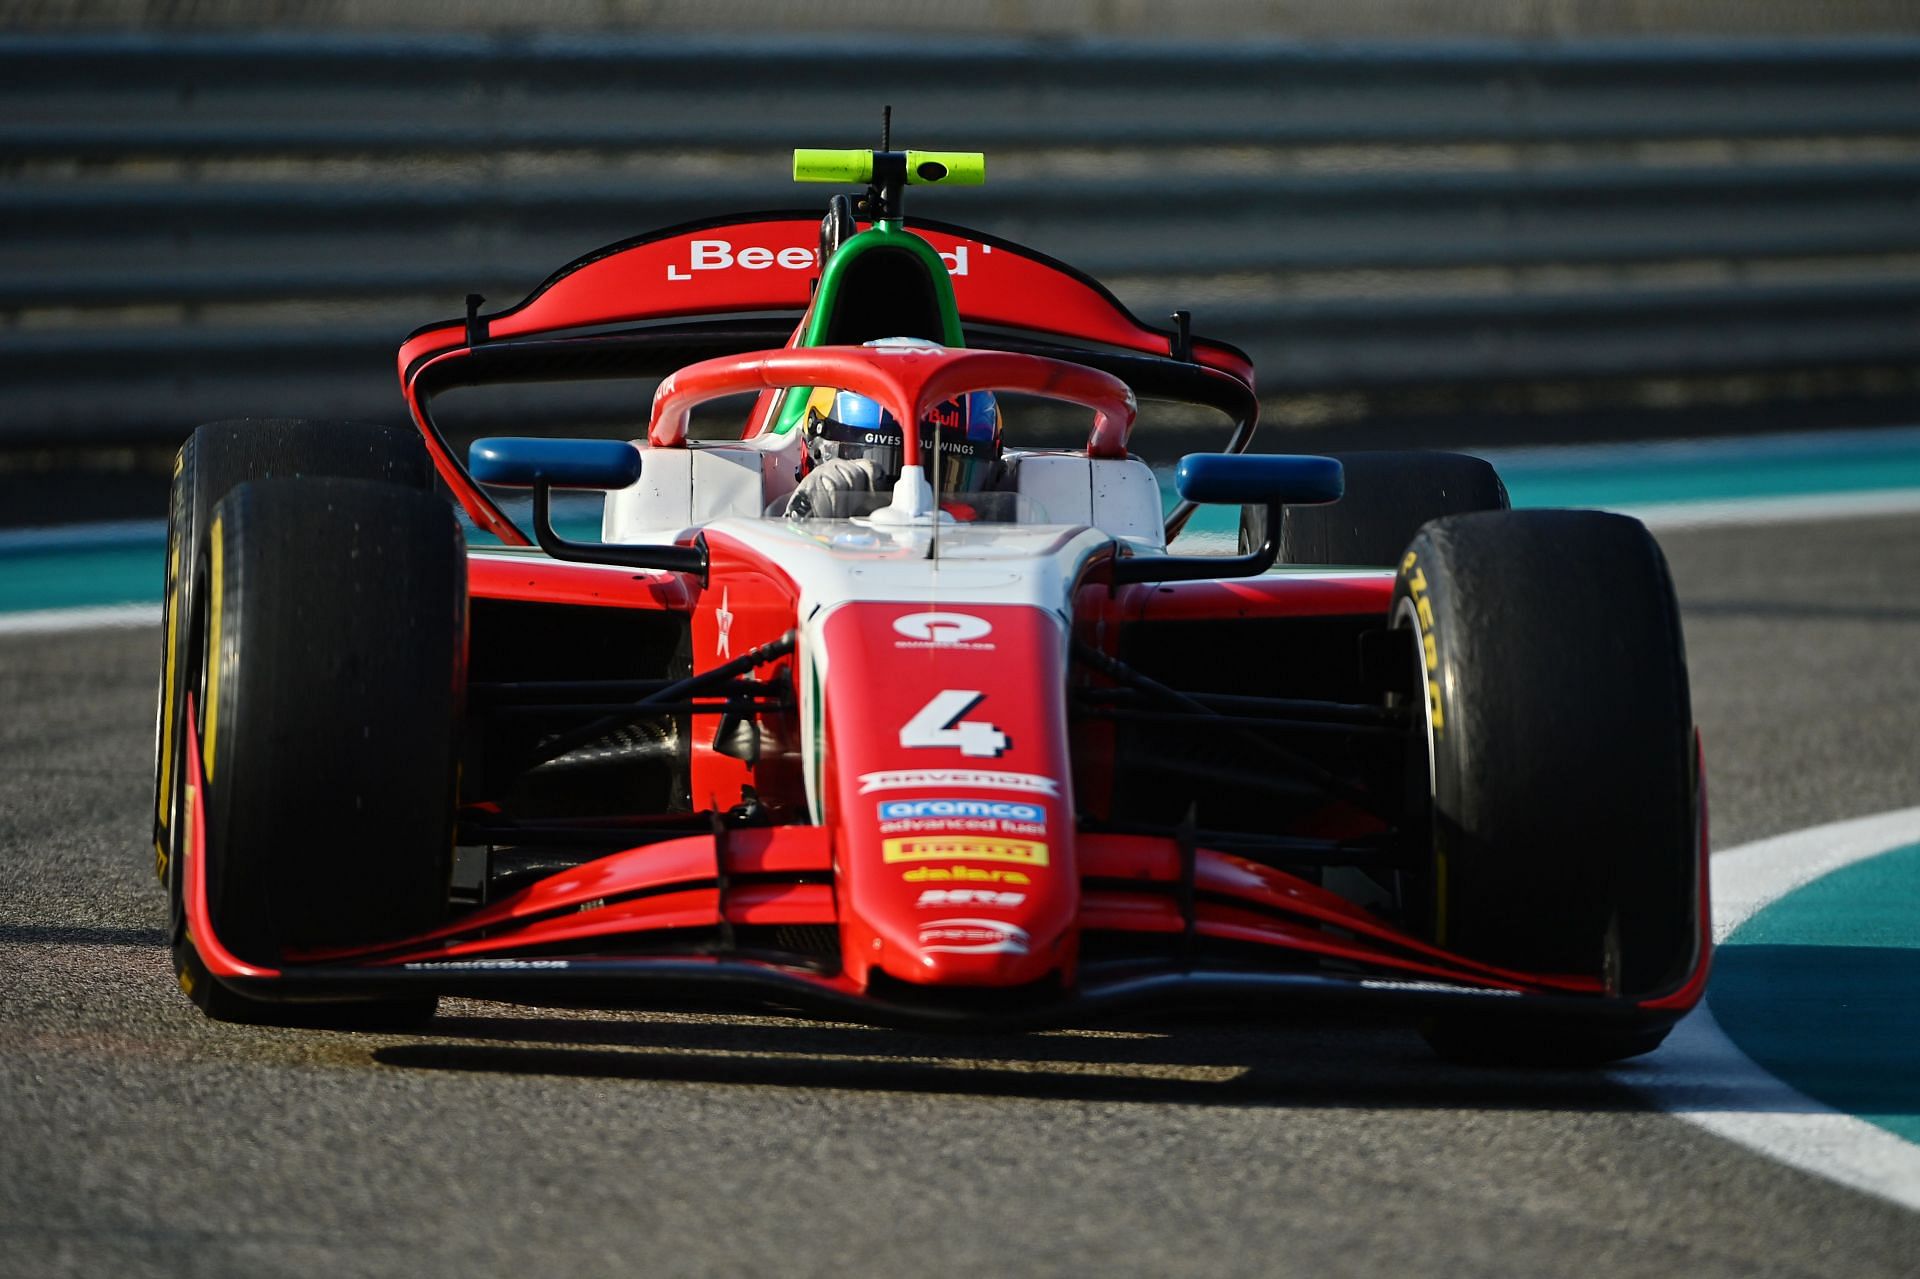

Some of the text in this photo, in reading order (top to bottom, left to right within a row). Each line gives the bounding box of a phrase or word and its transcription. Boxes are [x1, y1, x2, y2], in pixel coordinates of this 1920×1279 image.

[929, 408, 959, 428] Bull
[865, 433, 974, 455] GIVES WINGS
[899, 689, 1012, 758] 4
[888, 801, 1037, 819] aramco
[880, 818, 1047, 836] advanced fuel
[900, 841, 1034, 857] PIRELLI
[902, 865, 1031, 885] dallara
